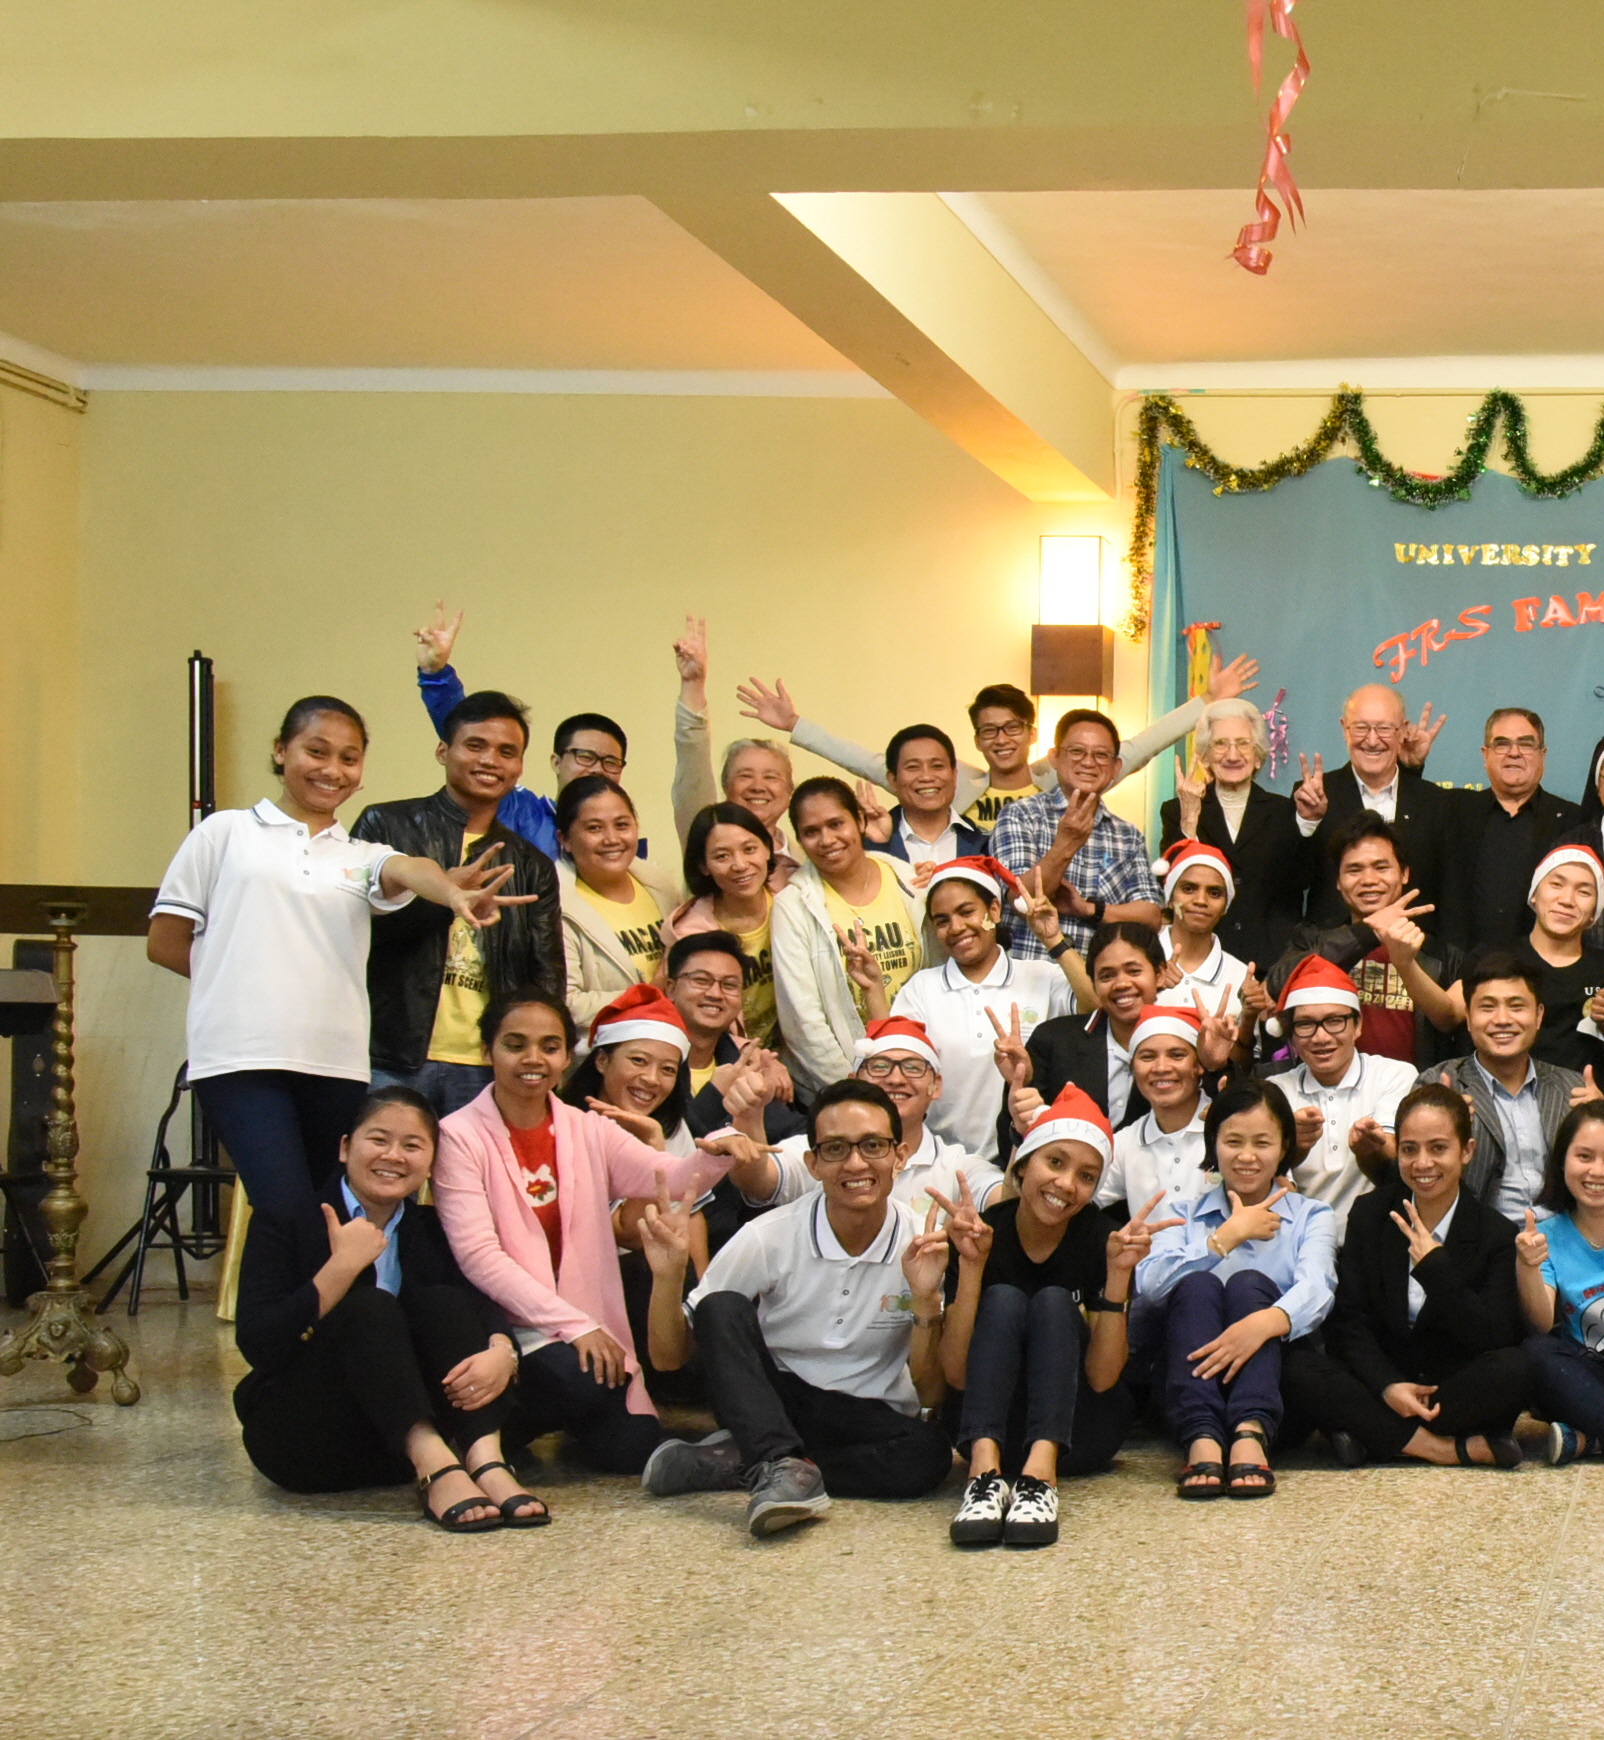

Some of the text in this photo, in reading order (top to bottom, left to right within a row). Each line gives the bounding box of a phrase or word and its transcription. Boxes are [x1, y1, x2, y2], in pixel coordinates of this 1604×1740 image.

[1394, 542, 1597, 567] UNIVERSITY
[1373, 604, 1493, 684] FRS
[880, 957, 908, 971] TOWER
[457, 975, 485, 993] SCENE
